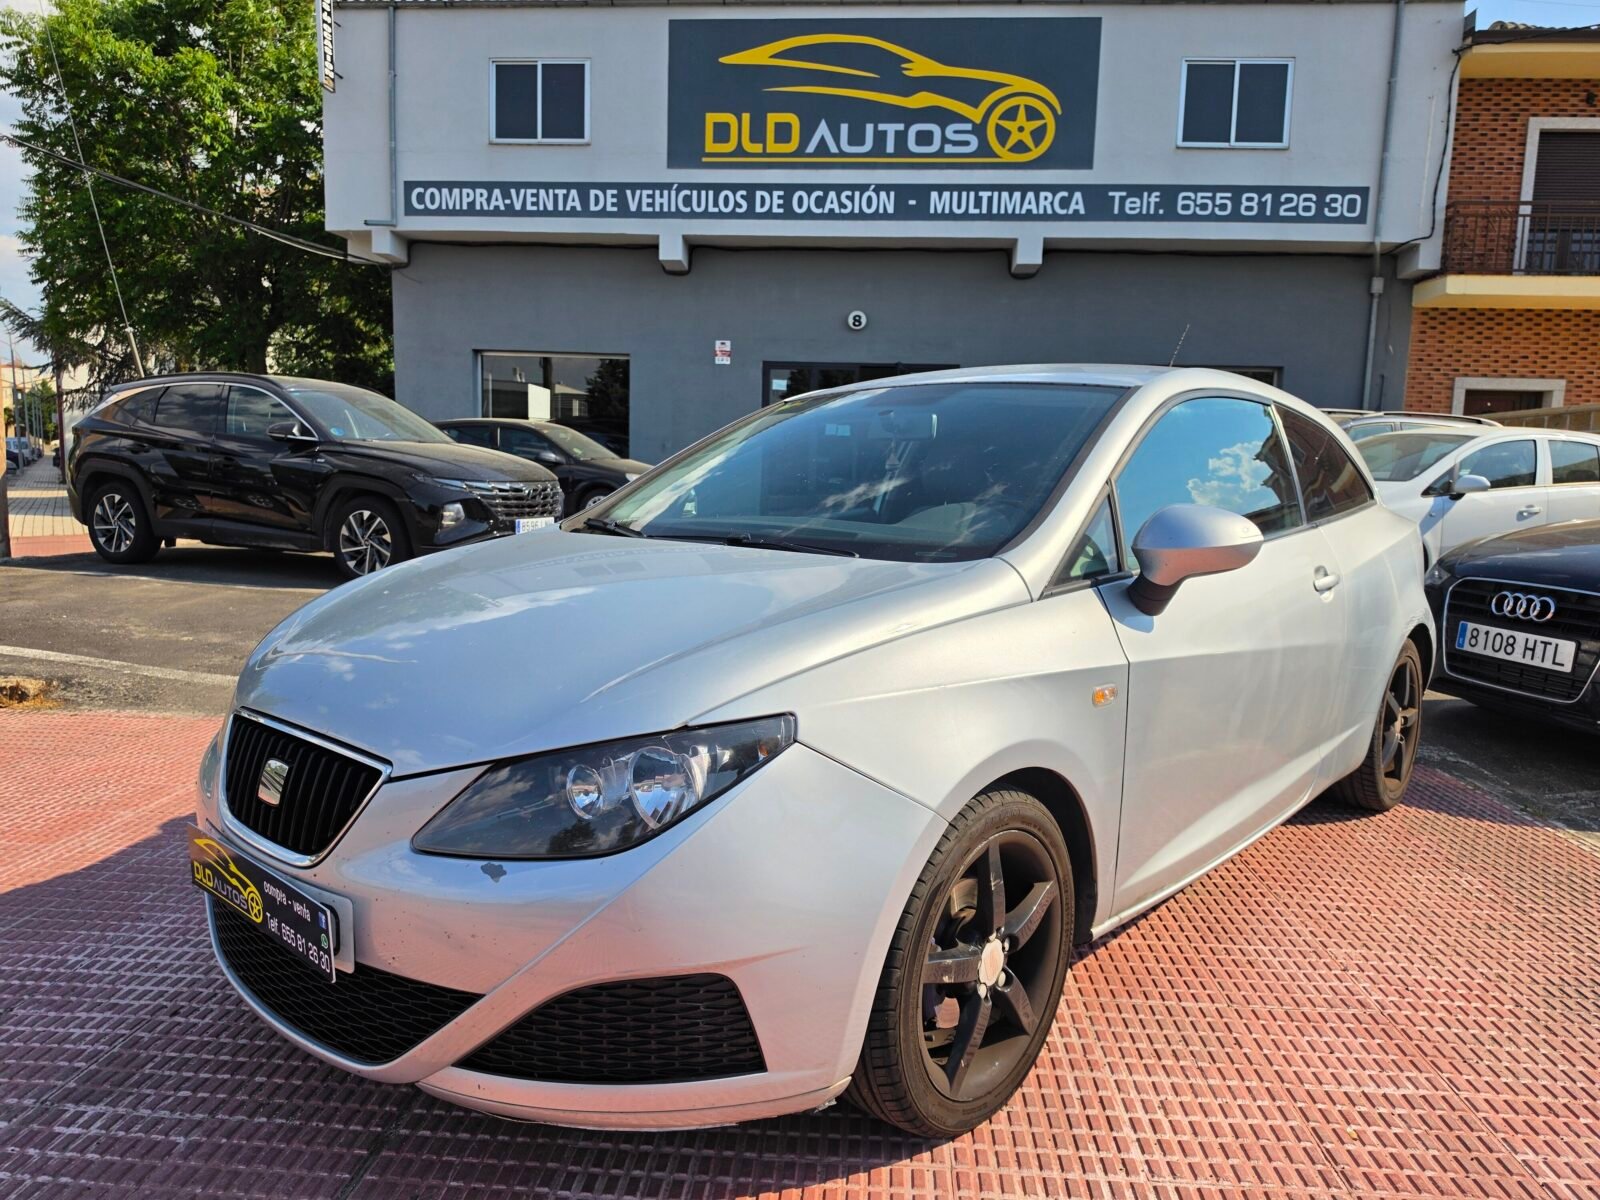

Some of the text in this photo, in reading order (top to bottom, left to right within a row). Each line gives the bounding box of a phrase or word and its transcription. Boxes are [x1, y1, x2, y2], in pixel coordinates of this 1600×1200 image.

[705, 112, 979, 153] DLD AUTOS
[411, 187, 582, 212] COMPRA-VENTA
[589, 189, 618, 212] DE
[625, 184, 748, 213] VEHÍCULOS
[755, 190, 785, 213] DE
[792, 185, 895, 214] OCASIÓN
[929, 191, 1086, 215] MULTIMARCA
[1108, 191, 1164, 215] Telf.
[1177, 192, 1232, 216] 655
[1240, 193, 1272, 216] 81
[1279, 194, 1316, 216] 26
[1324, 194, 1362, 218] 30
[852, 314, 862, 327] 8
[1468, 628, 1565, 667] 8108 HTL
[193, 861, 248, 910] DLD AUTOS
[264, 880, 287, 906] compra
[293, 901, 311, 922] venta
[266, 912, 331, 973] Telf. 655 81 26 30
